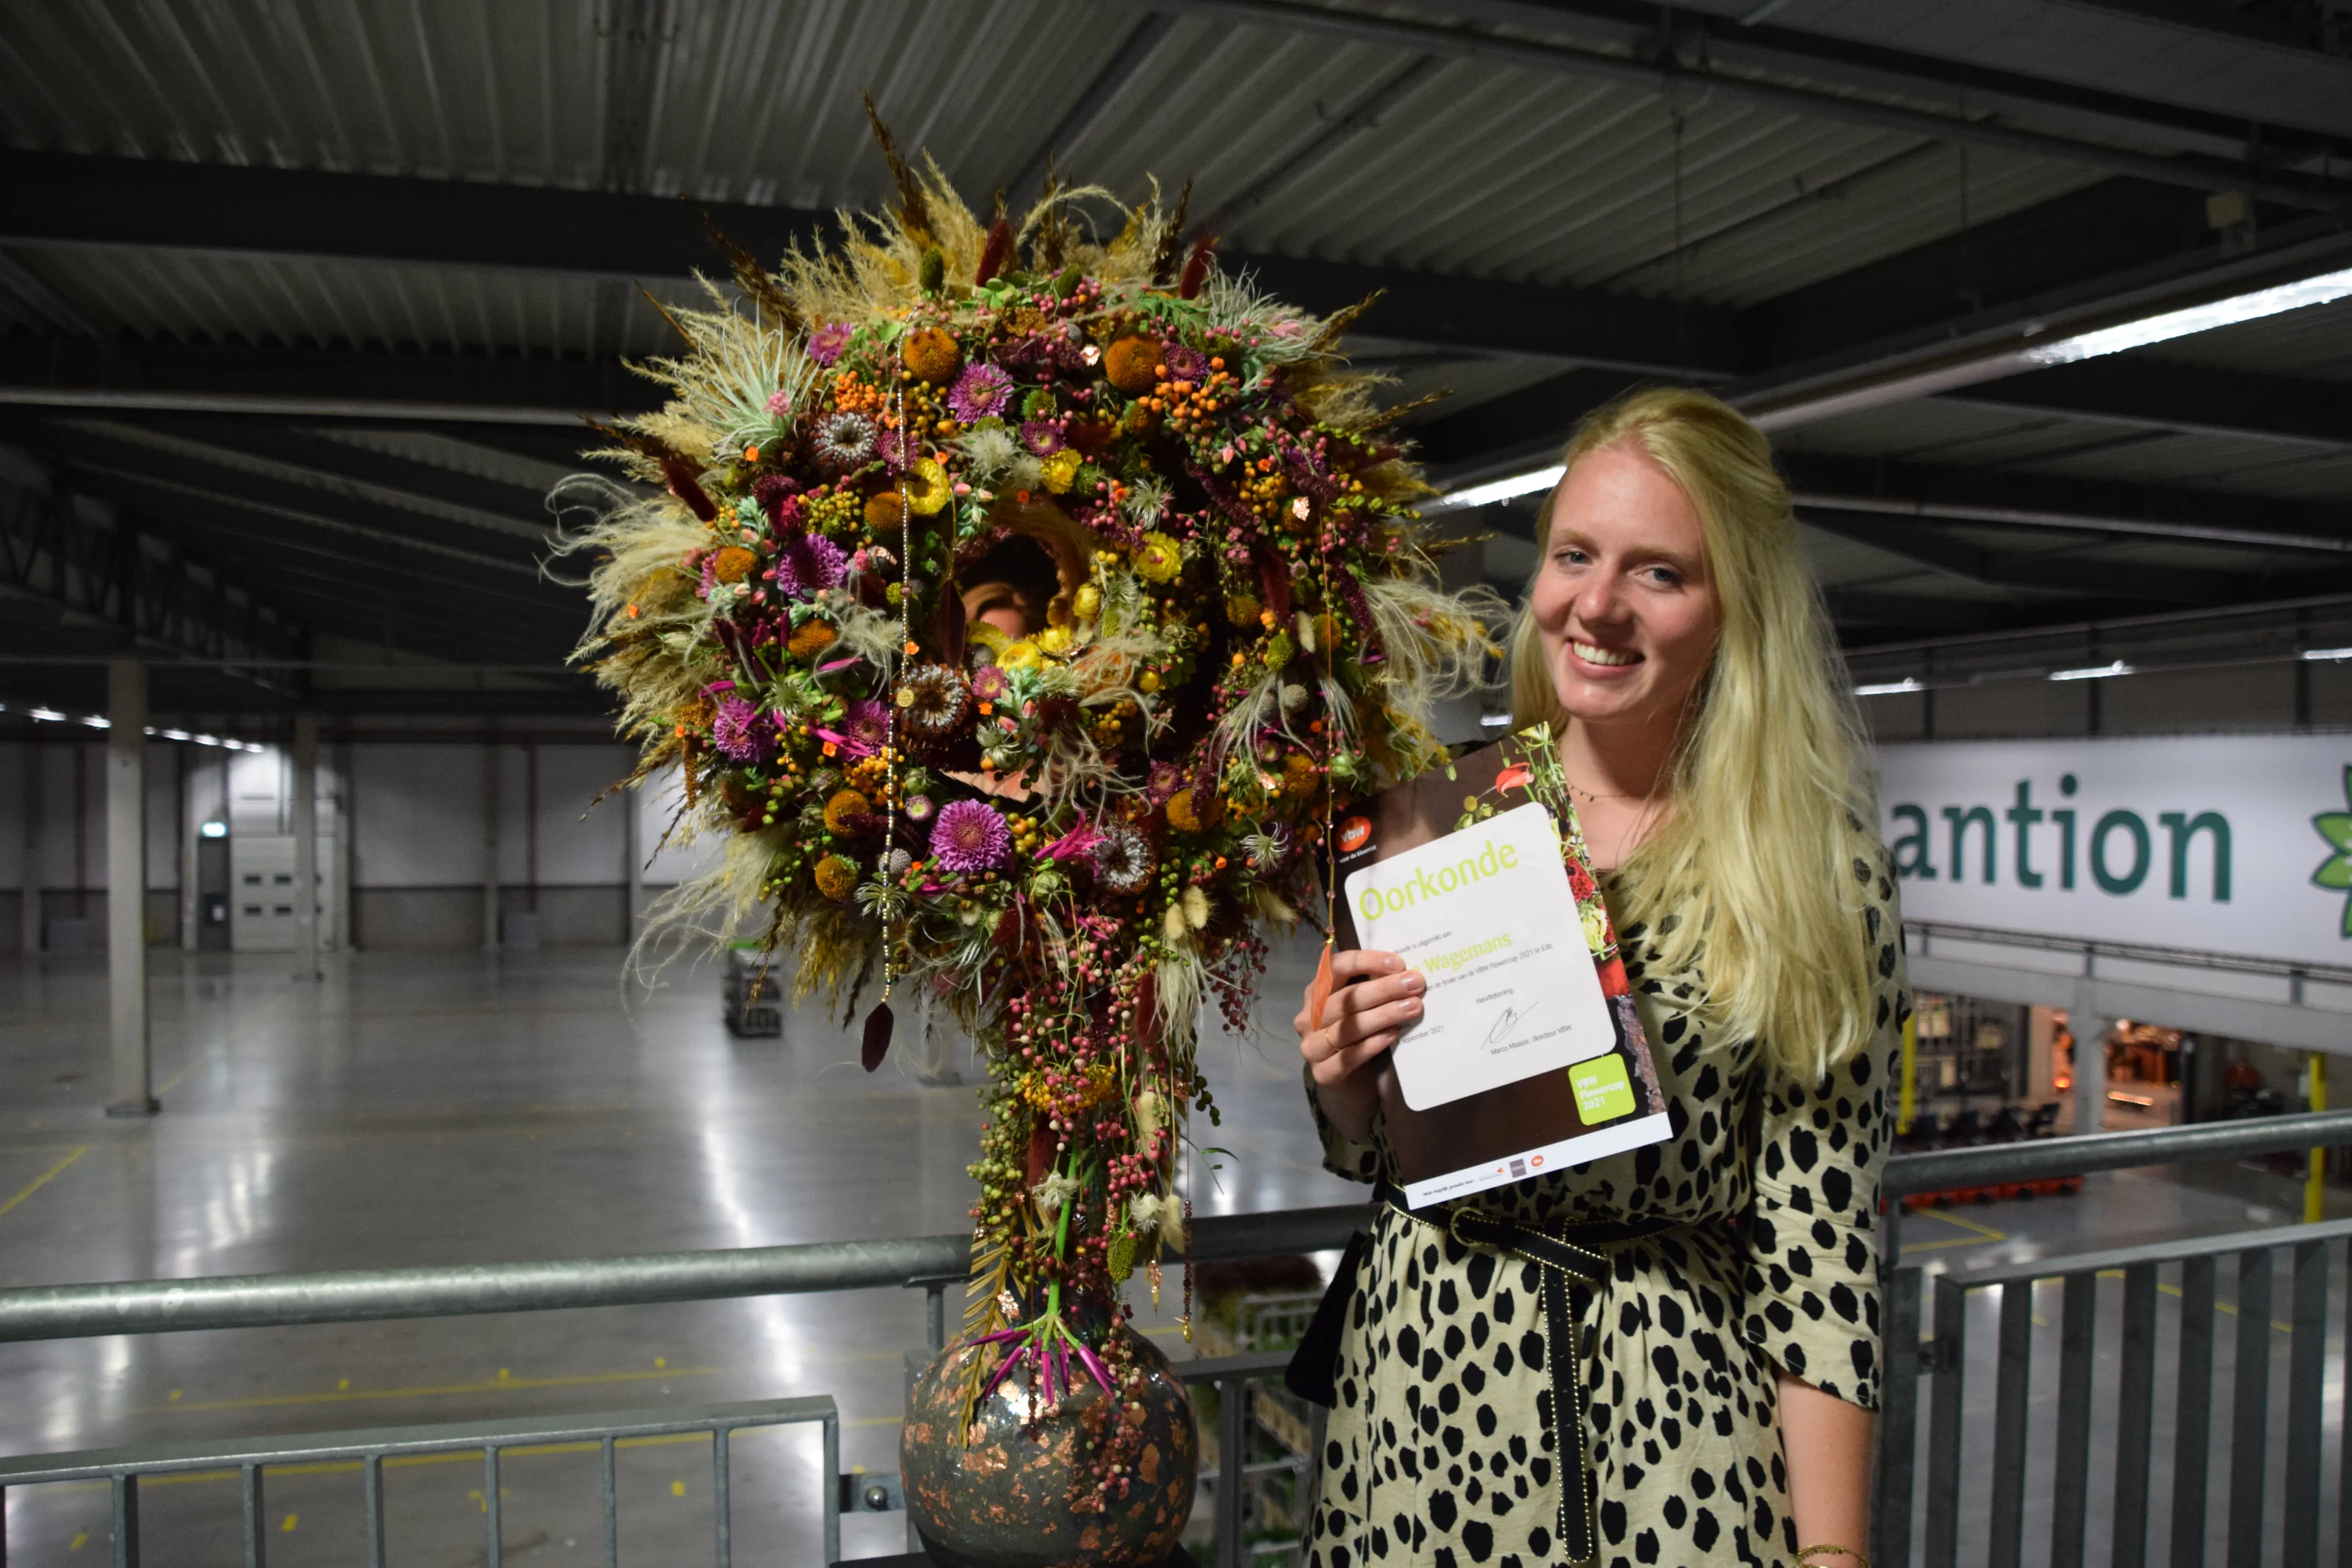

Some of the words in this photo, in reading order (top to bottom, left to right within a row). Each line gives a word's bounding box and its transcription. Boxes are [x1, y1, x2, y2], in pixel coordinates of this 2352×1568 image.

[1893, 774, 2232, 903] antion
[1357, 845, 1377, 856] bloemist
[1359, 840, 1518, 921] Oorkonde
[1417, 934, 1442, 947] uitgereikt
[1442, 930, 1452, 939] aan
[1423, 933, 1512, 973] Wagemans
[1442, 977, 1457, 986] finale
[1476, 965, 1490, 973] VBW
[1490, 956, 1518, 970] Flowercup
[1519, 949, 1534, 960] 2021
[1430, 1025, 1444, 1035] 2021
[1491, 1045, 1509, 1055] Marco
[1532, 1030, 1556, 1042] directeur
[1557, 1024, 1572, 1035] VBW
[1575, 1074, 1597, 1088] VBW
[1579, 1080, 1625, 1099] Flowercup
[1582, 1096, 1606, 1111] 2021
